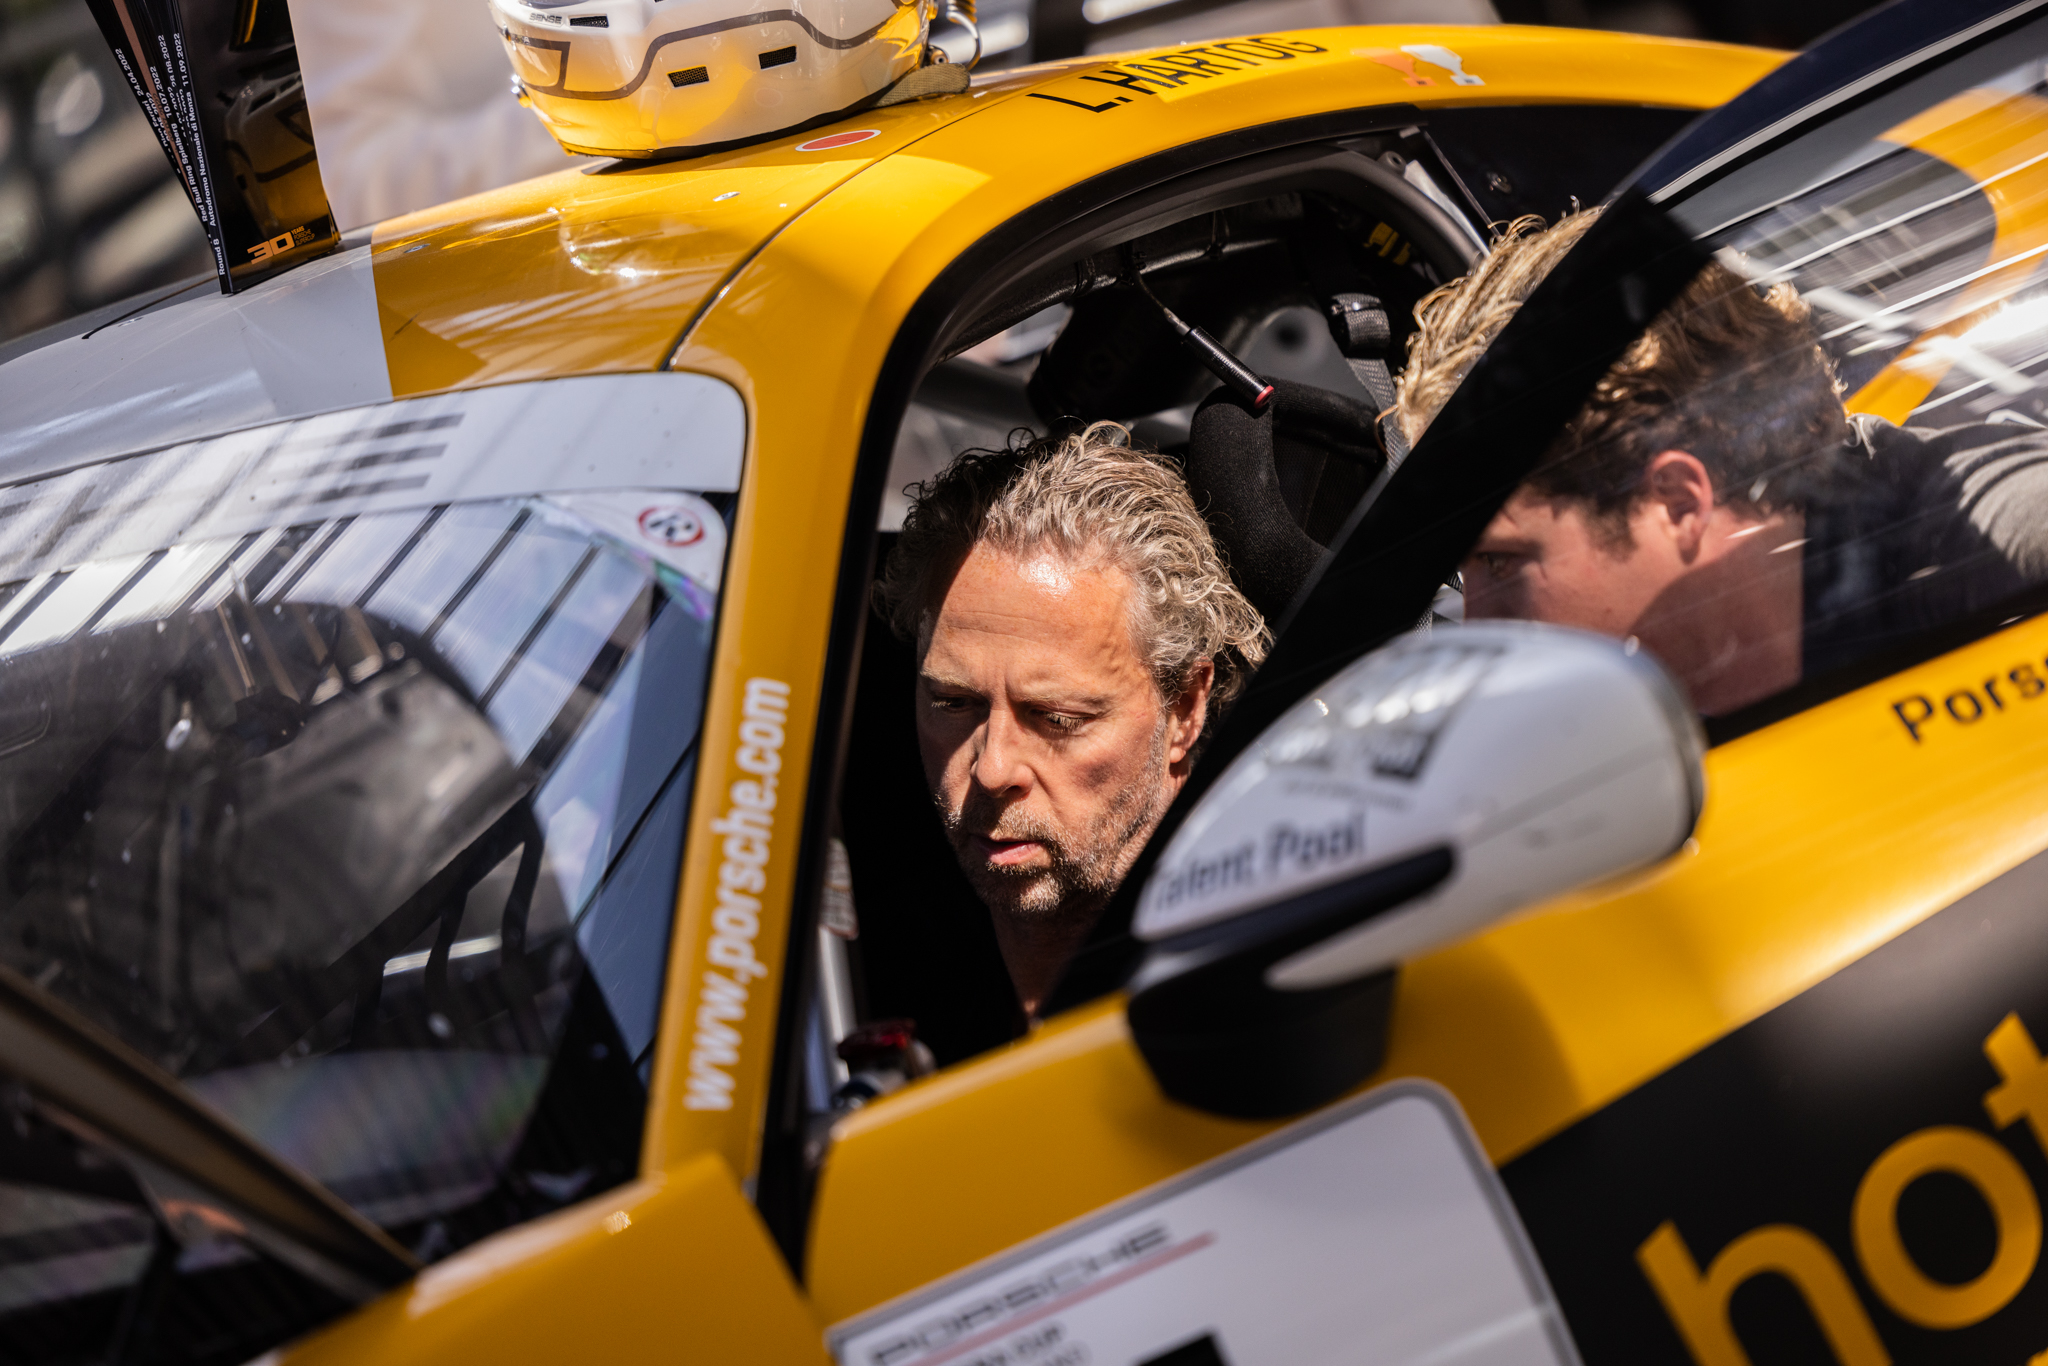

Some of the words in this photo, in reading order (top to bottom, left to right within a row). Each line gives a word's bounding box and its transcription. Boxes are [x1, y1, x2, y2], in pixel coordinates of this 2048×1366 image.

[114, 47, 144, 96] 24.04.2022
[173, 32, 189, 87] 11.09.2022
[149, 65, 172, 118] 10.07.2022
[186, 91, 196, 122] Monza
[171, 122, 189, 165] Spielberg
[190, 122, 198, 131] di
[193, 132, 206, 176] Nazionale
[185, 165, 197, 186] Ring
[191, 186, 203, 204] Bull
[197, 204, 208, 222] Red
[202, 176, 216, 227] Autodromo
[213, 238, 220, 246] 8
[214, 246, 226, 276] Round
[247, 231, 295, 265] 30
[1266, 812, 1364, 880] Pool
[684, 677, 790, 1111] www.porsche.com
